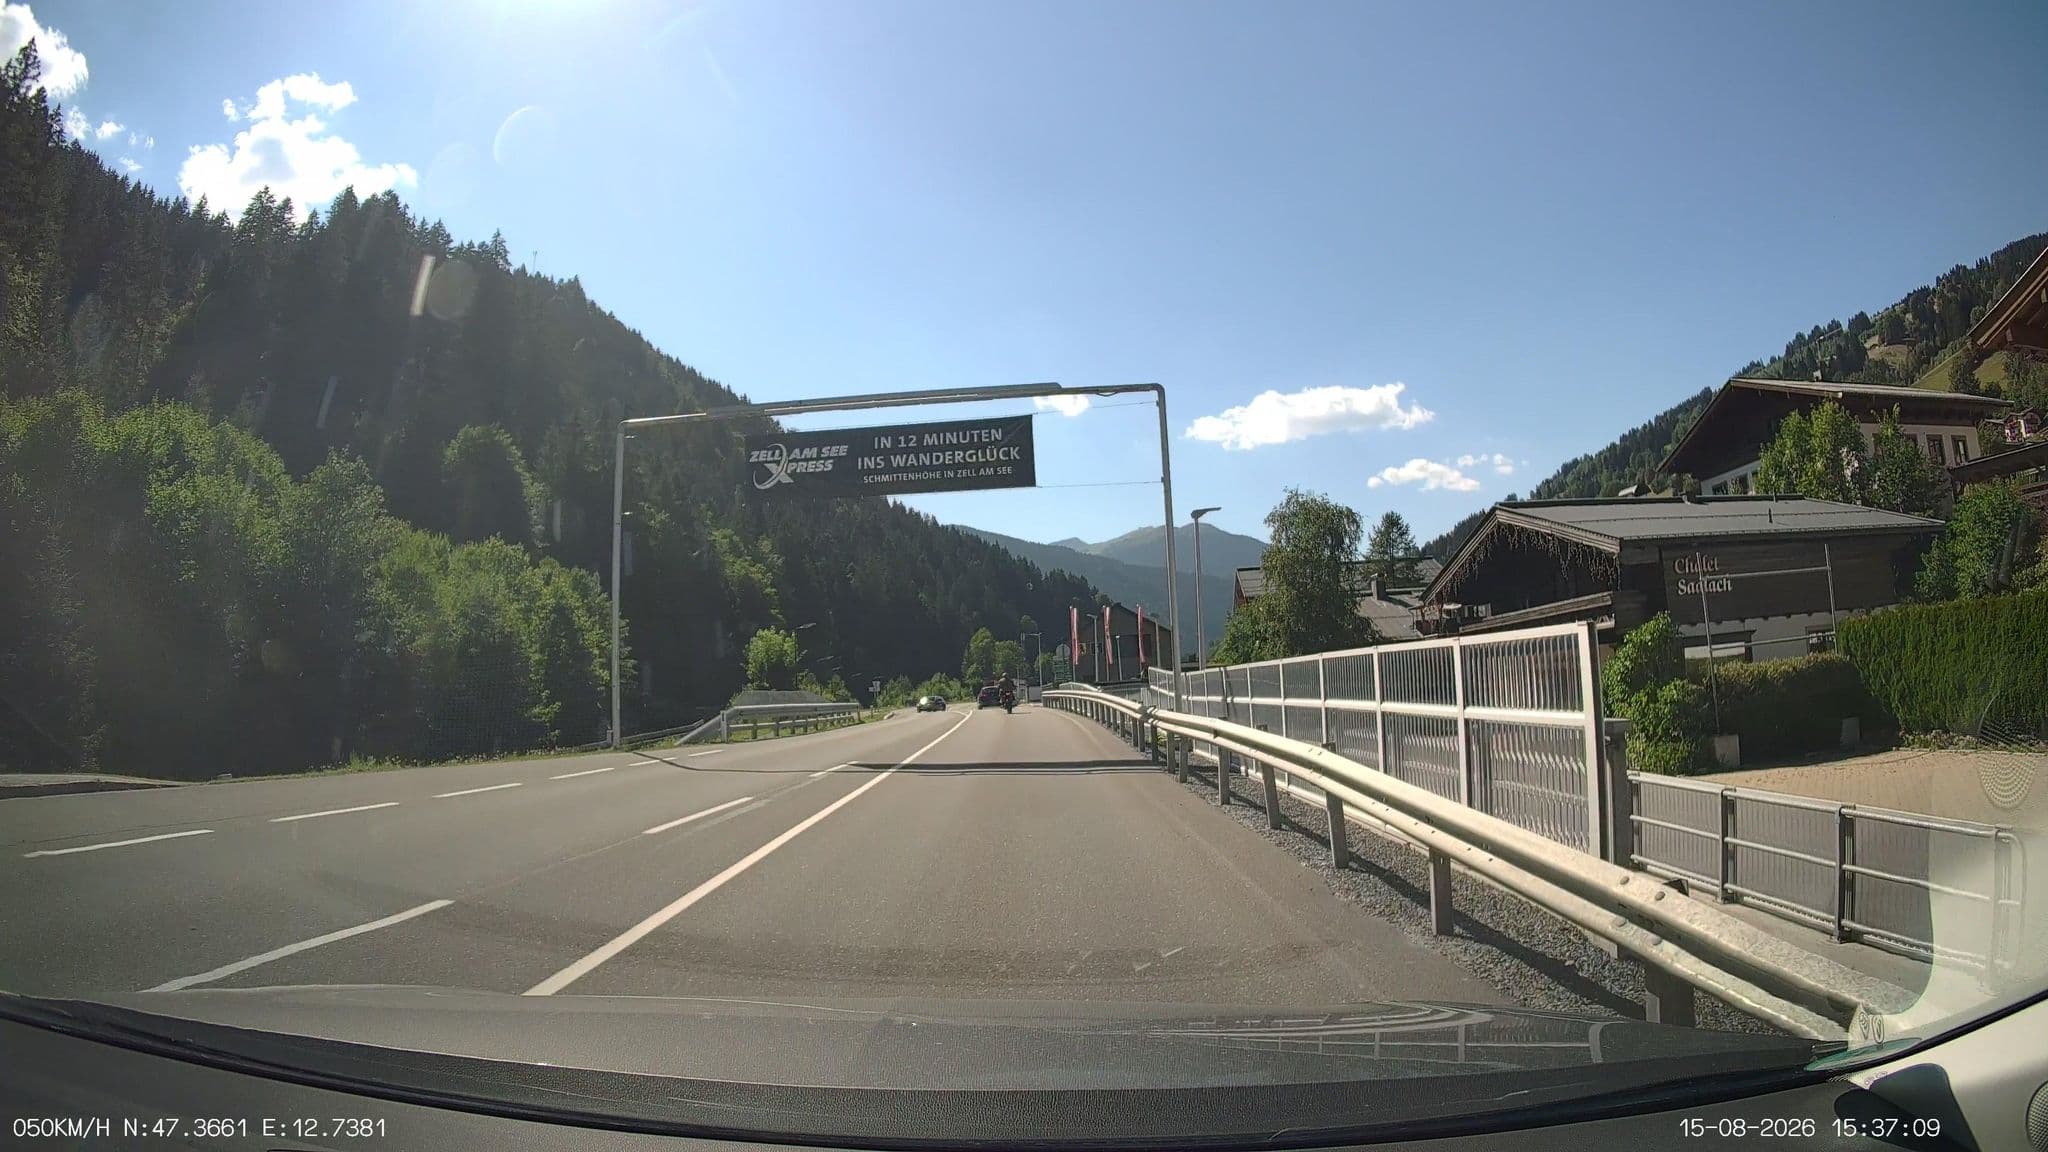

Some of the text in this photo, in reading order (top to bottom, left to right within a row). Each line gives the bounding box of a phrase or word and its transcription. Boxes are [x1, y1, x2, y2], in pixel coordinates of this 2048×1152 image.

[874, 428, 1003, 450] IN 12 MINUTEN
[750, 445, 849, 463] ZELL AM SEE
[857, 446, 1021, 470] INS WANDERGLÜCK
[943, 470, 954, 478] IN
[957, 469, 977, 478] ZELL
[979, 467, 994, 476] AM
[996, 466, 1013, 475] SEE
[1674, 554, 1719, 574] Chalet
